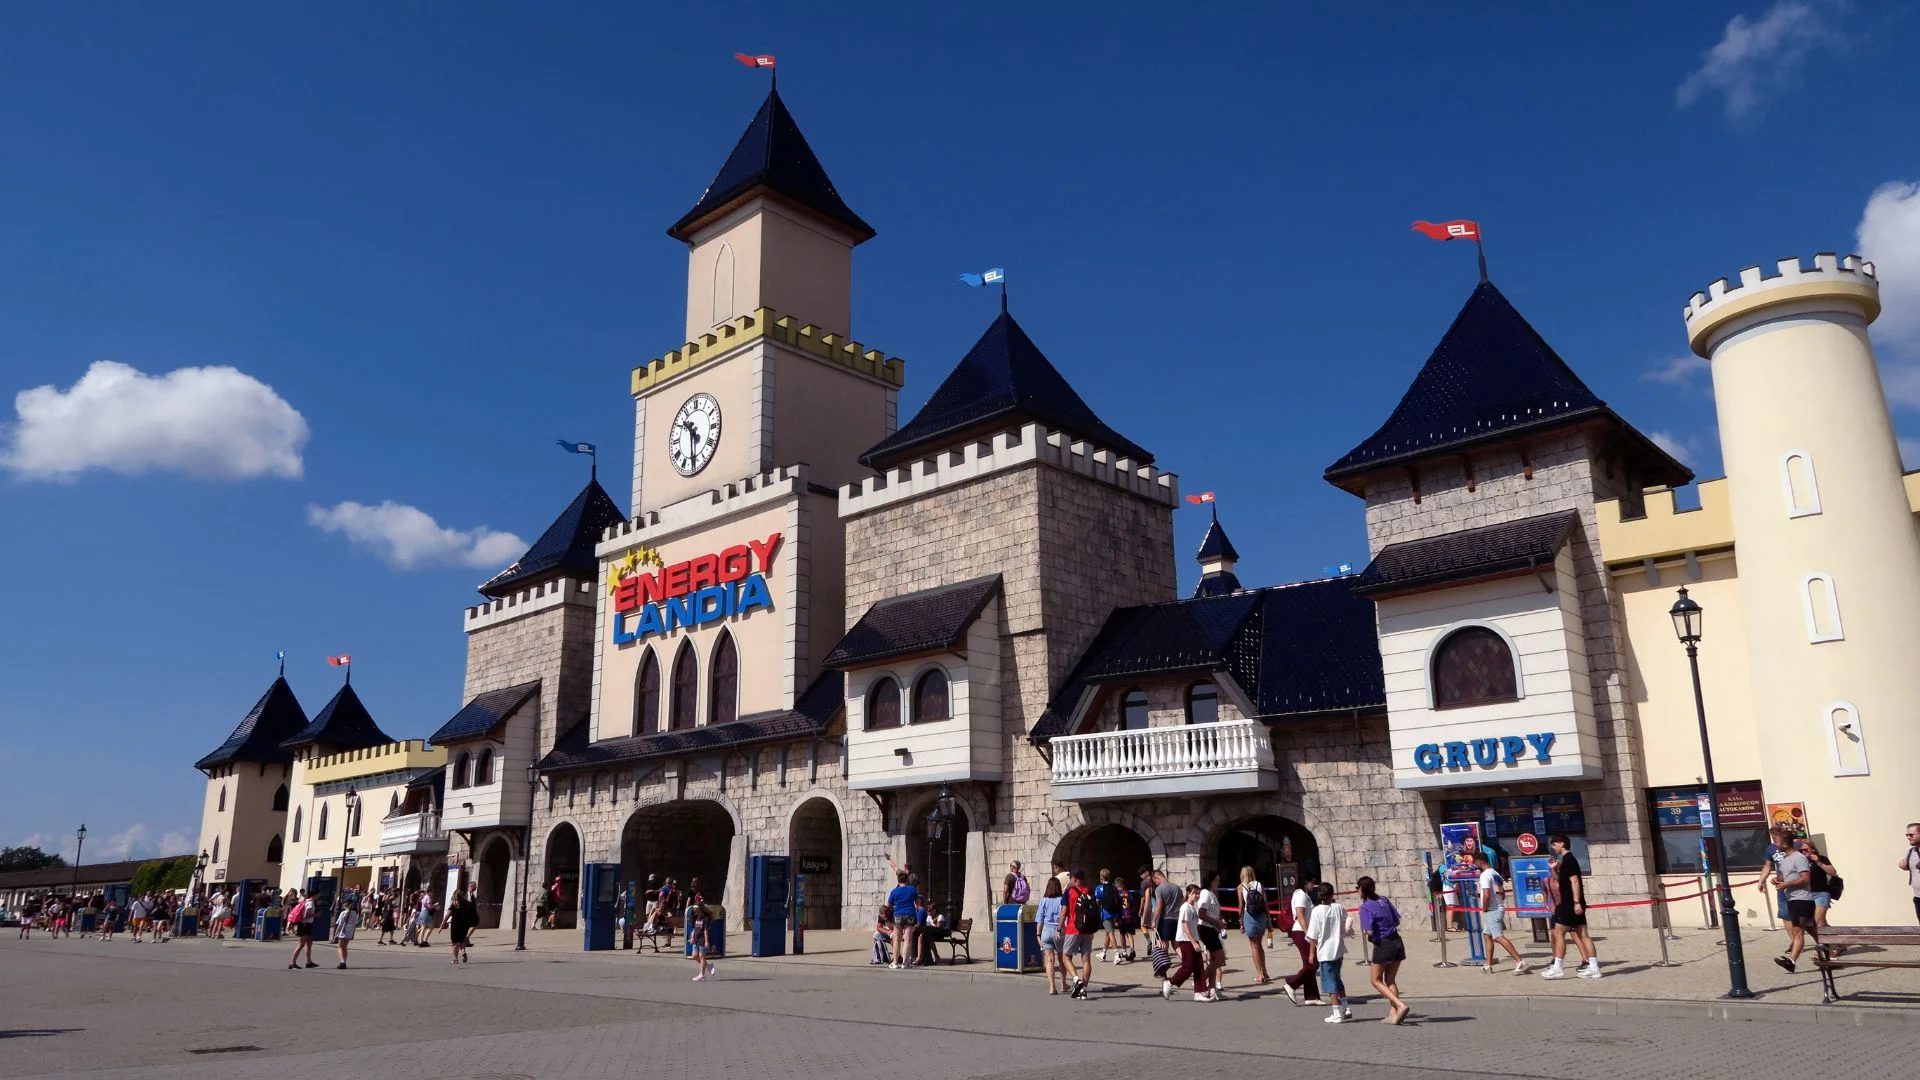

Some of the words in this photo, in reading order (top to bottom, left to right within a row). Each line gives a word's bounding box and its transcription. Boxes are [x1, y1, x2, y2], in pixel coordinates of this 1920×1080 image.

[1447, 224, 1475, 236] EL
[985, 270, 1002, 282] EL
[577, 444, 593, 453] EL
[614, 532, 782, 612] ENERGY
[613, 573, 772, 645] LANDIA
[1413, 732, 1556, 771] GRUPY
[691, 789, 726, 803] LANDIA
[1670, 807, 1681, 815] 39
[1520, 839, 1535, 848] EL
